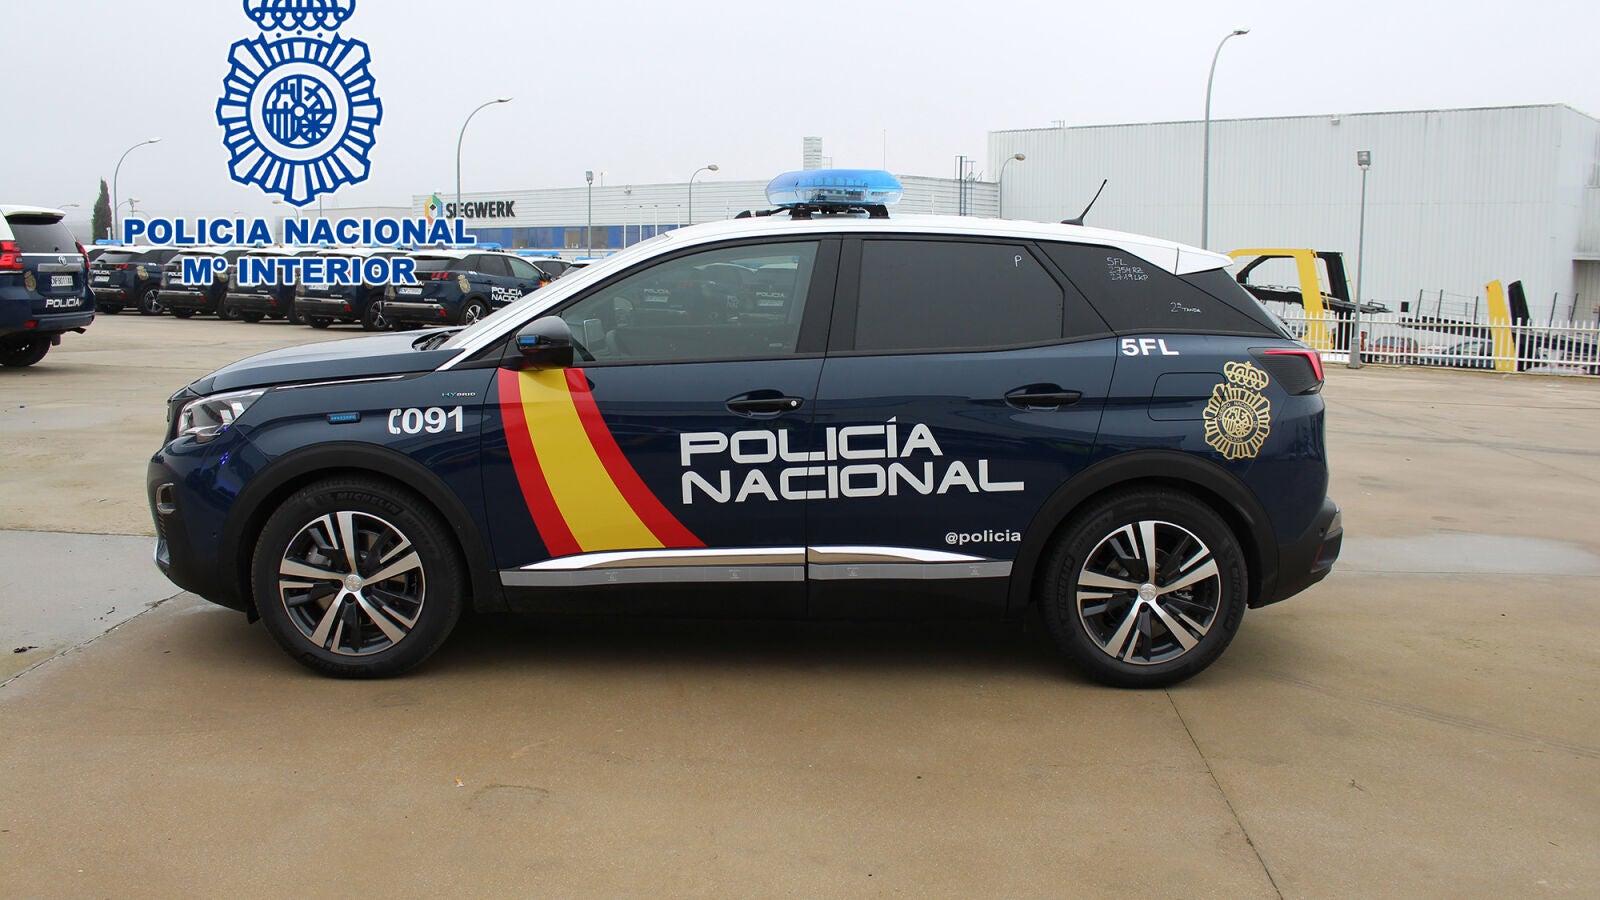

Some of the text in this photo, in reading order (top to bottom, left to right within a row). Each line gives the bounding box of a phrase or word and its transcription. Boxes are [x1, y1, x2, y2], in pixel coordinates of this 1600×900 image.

[445, 200, 517, 219] SIEGWERK
[1121, 338, 1180, 356] 5FL
[401, 406, 463, 434] 091
[680, 415, 944, 467] POLICÍA
[681, 459, 1025, 505] NACIONAL
[945, 530, 1022, 546] @policia
